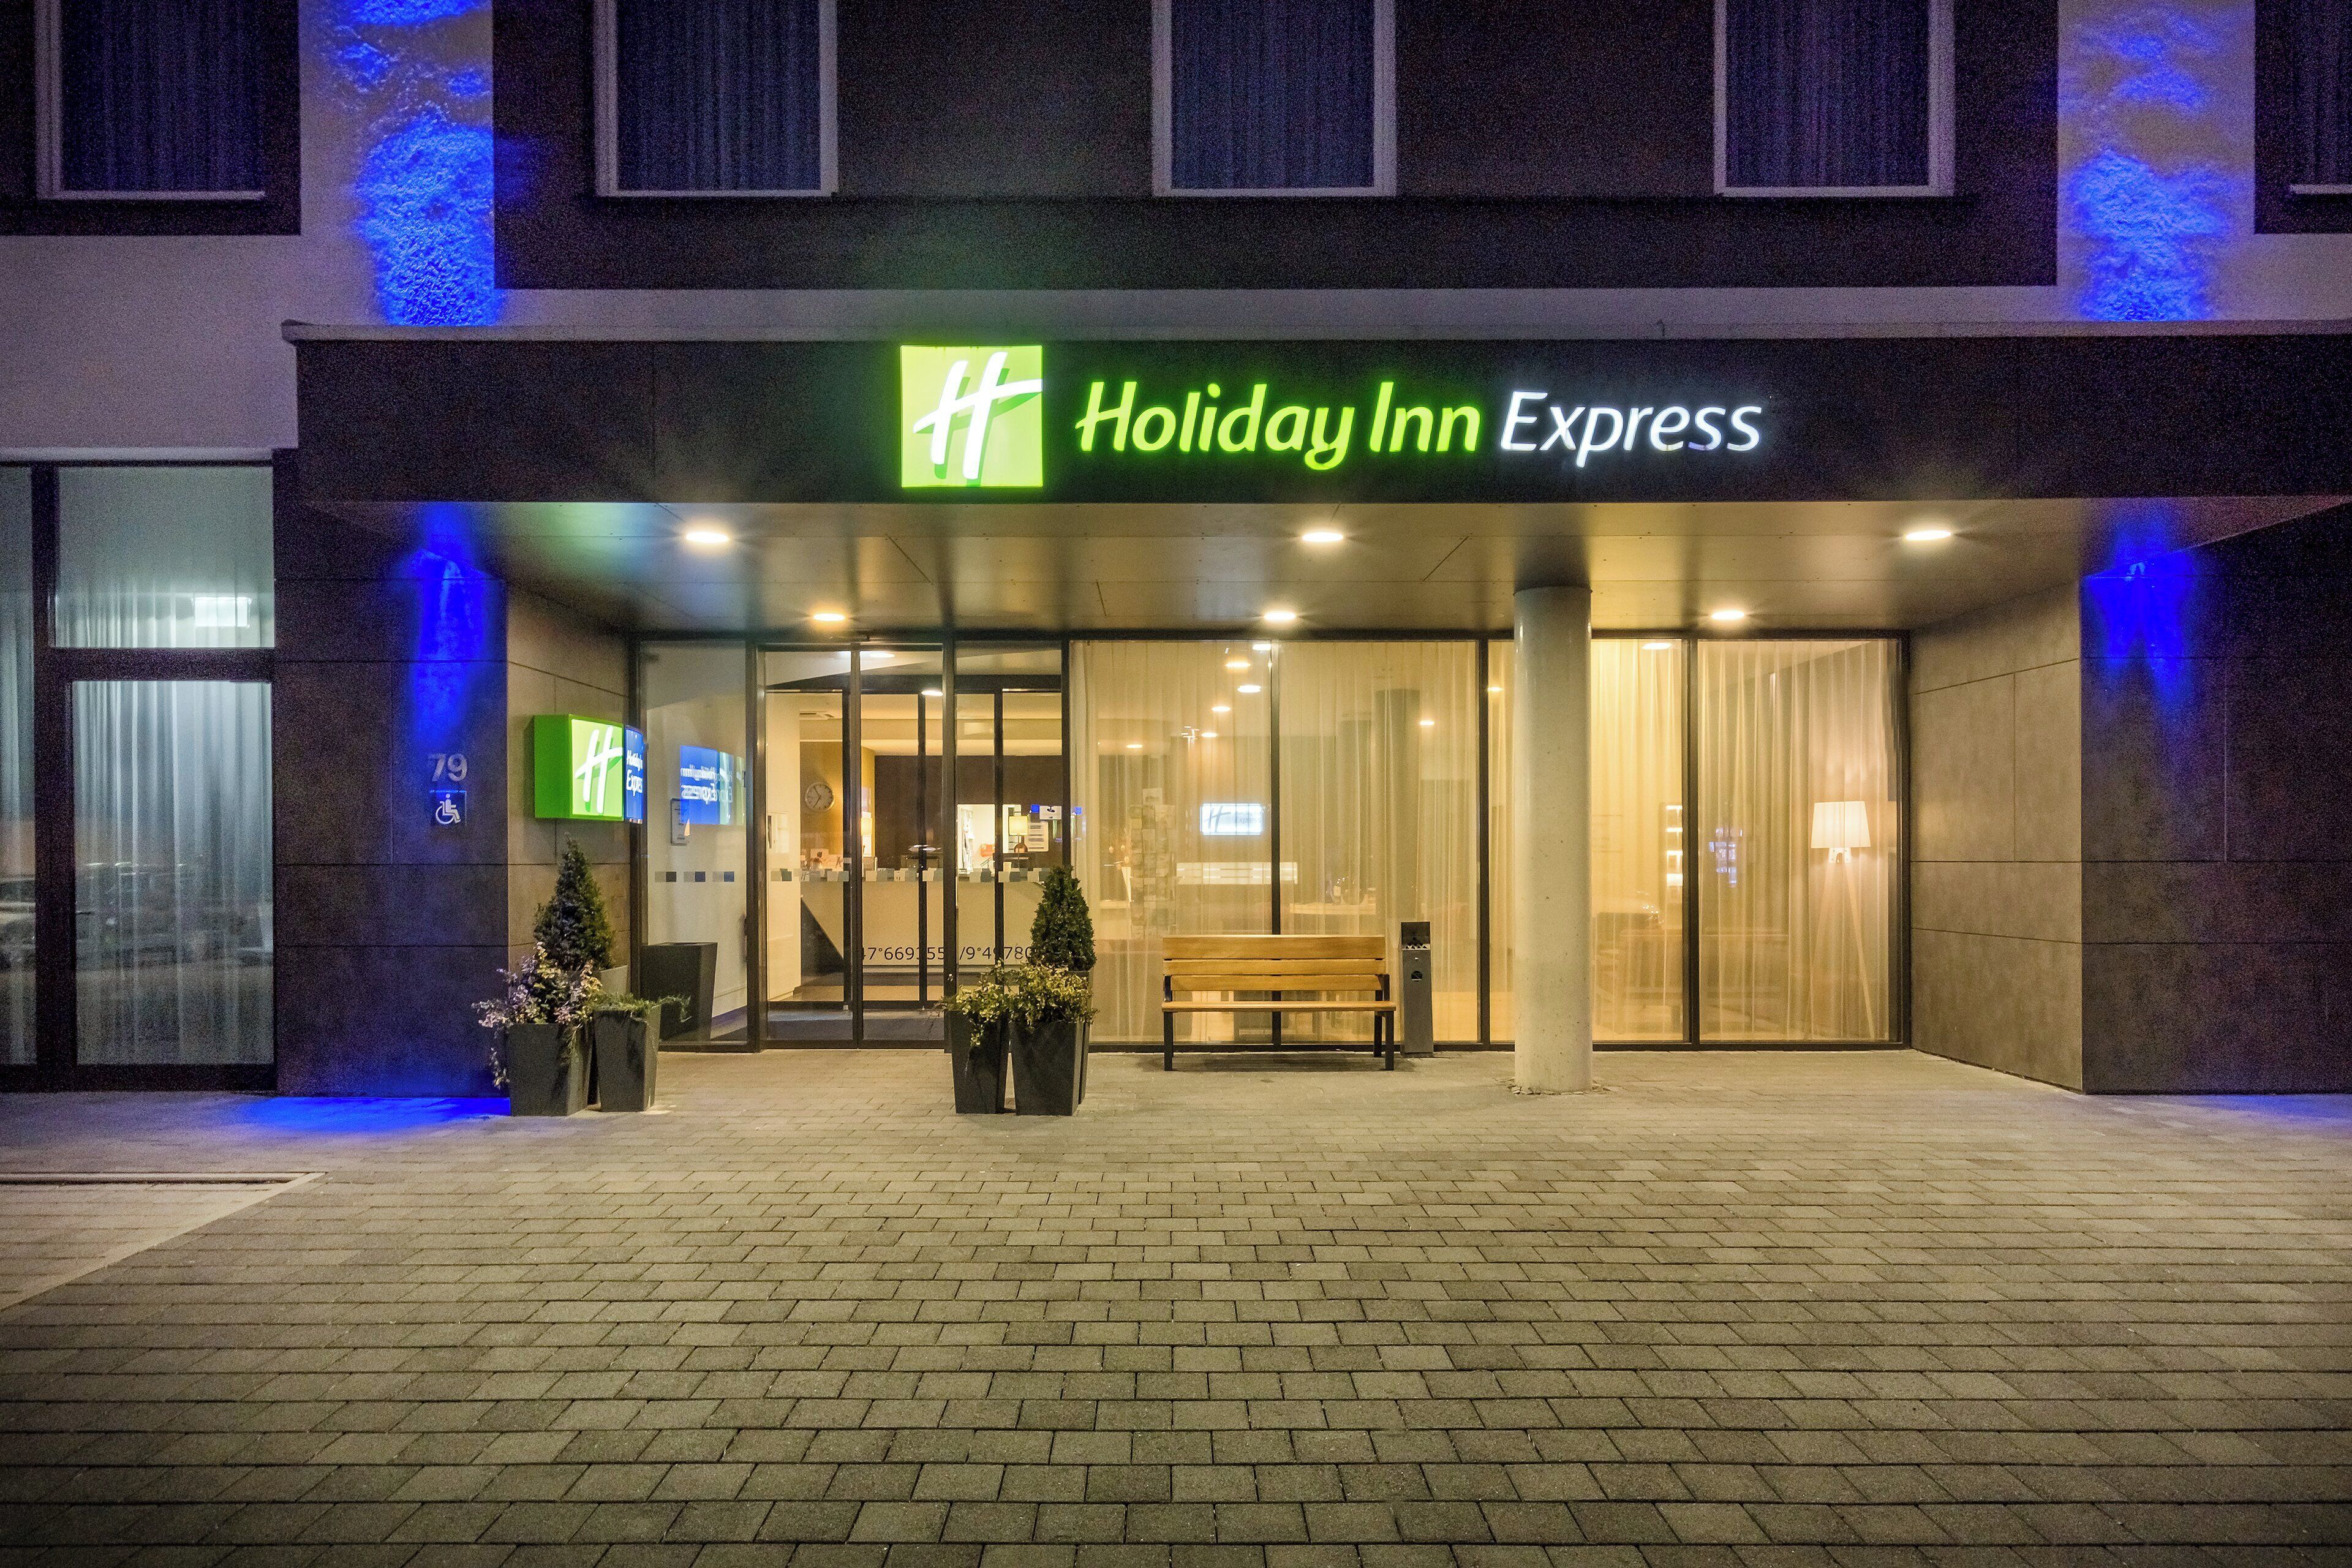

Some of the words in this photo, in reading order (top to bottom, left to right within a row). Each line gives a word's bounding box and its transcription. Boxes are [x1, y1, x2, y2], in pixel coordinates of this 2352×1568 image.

[1074, 381, 1355, 470] Holiday
[1370, 381, 1480, 452] Inn
[1500, 391, 1762, 468] Express
[428, 753, 467, 782] 79
